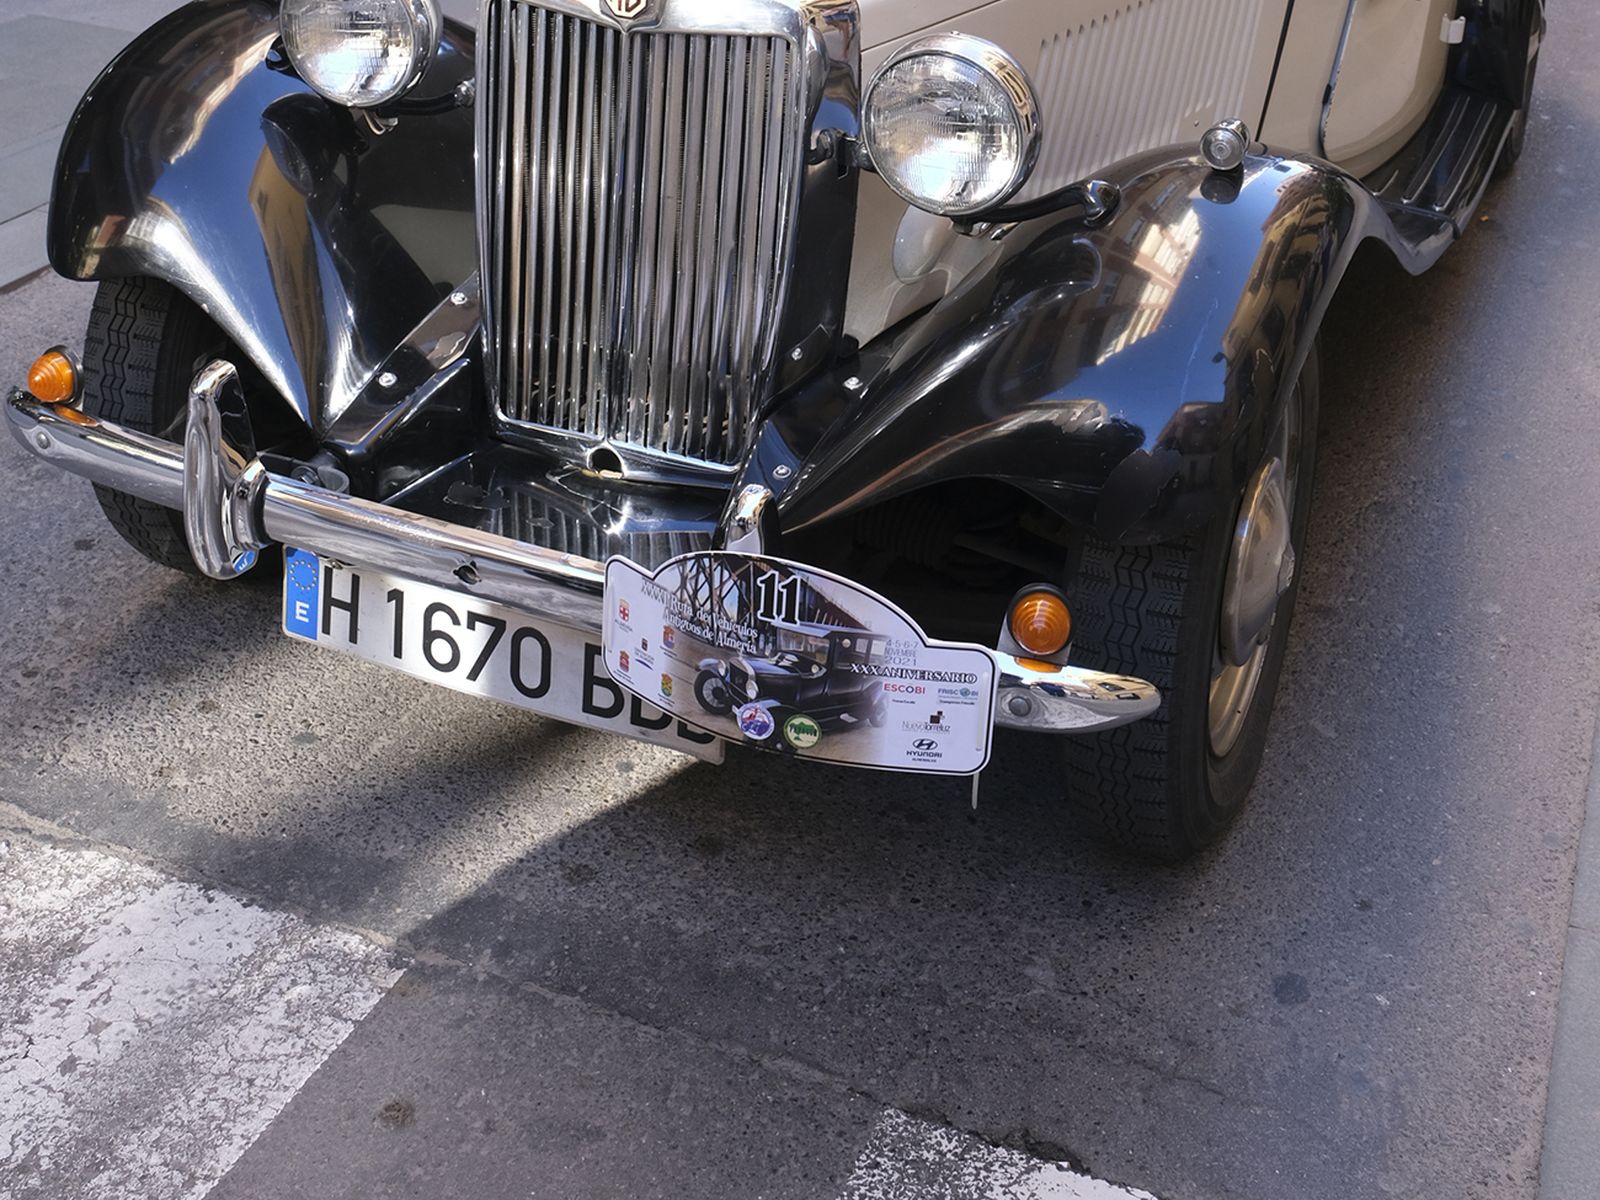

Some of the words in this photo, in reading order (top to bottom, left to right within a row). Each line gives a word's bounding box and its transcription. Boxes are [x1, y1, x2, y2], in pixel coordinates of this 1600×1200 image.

[757, 570, 801, 627] 11
[294, 600, 310, 623] E
[670, 594, 694, 617] Ruta
[713, 611, 758, 639] Vehículos
[321, 565, 361, 645] H
[386, 587, 552, 699] 1670
[663, 607, 701, 635] Antiguos
[702, 626, 714, 641] de
[715, 632, 757, 655] Almería
[884, 655, 917, 666] 2021
[850, 663, 881, 676] XXX
[880, 666, 978, 685] ANIVERSARIO
[883, 682, 926, 695] ESCOBI
[906, 750, 943, 758] HYUNDAI
